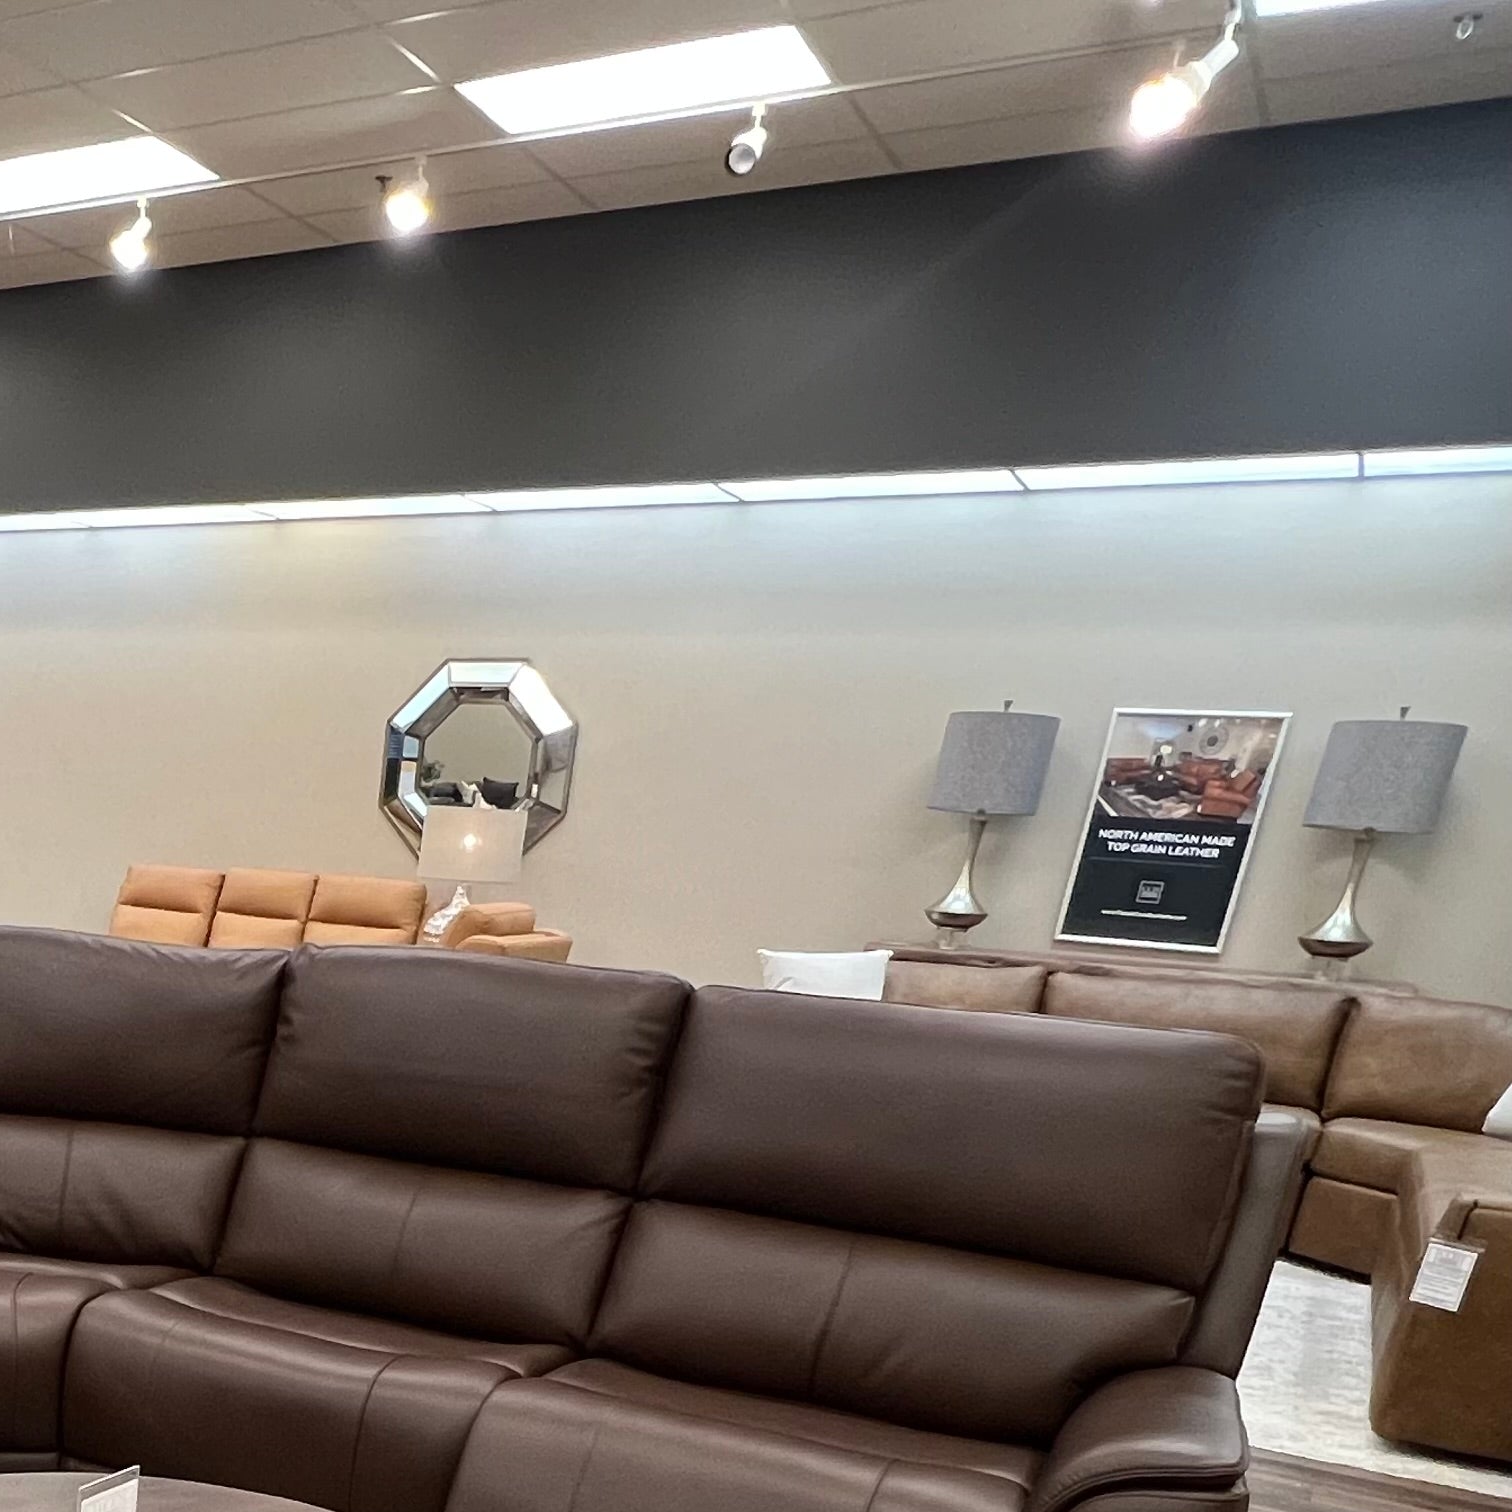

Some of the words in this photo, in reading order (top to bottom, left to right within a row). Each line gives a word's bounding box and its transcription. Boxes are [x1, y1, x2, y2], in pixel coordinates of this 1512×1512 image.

[1098, 828, 1139, 841] NORTH
[1139, 831, 1199, 844] AMERICAN
[1201, 834, 1237, 847] MADE
[1107, 840, 1130, 852] TOP
[1130, 843, 1167, 855] GRAIN
[1167, 845, 1220, 858] LEATHER
